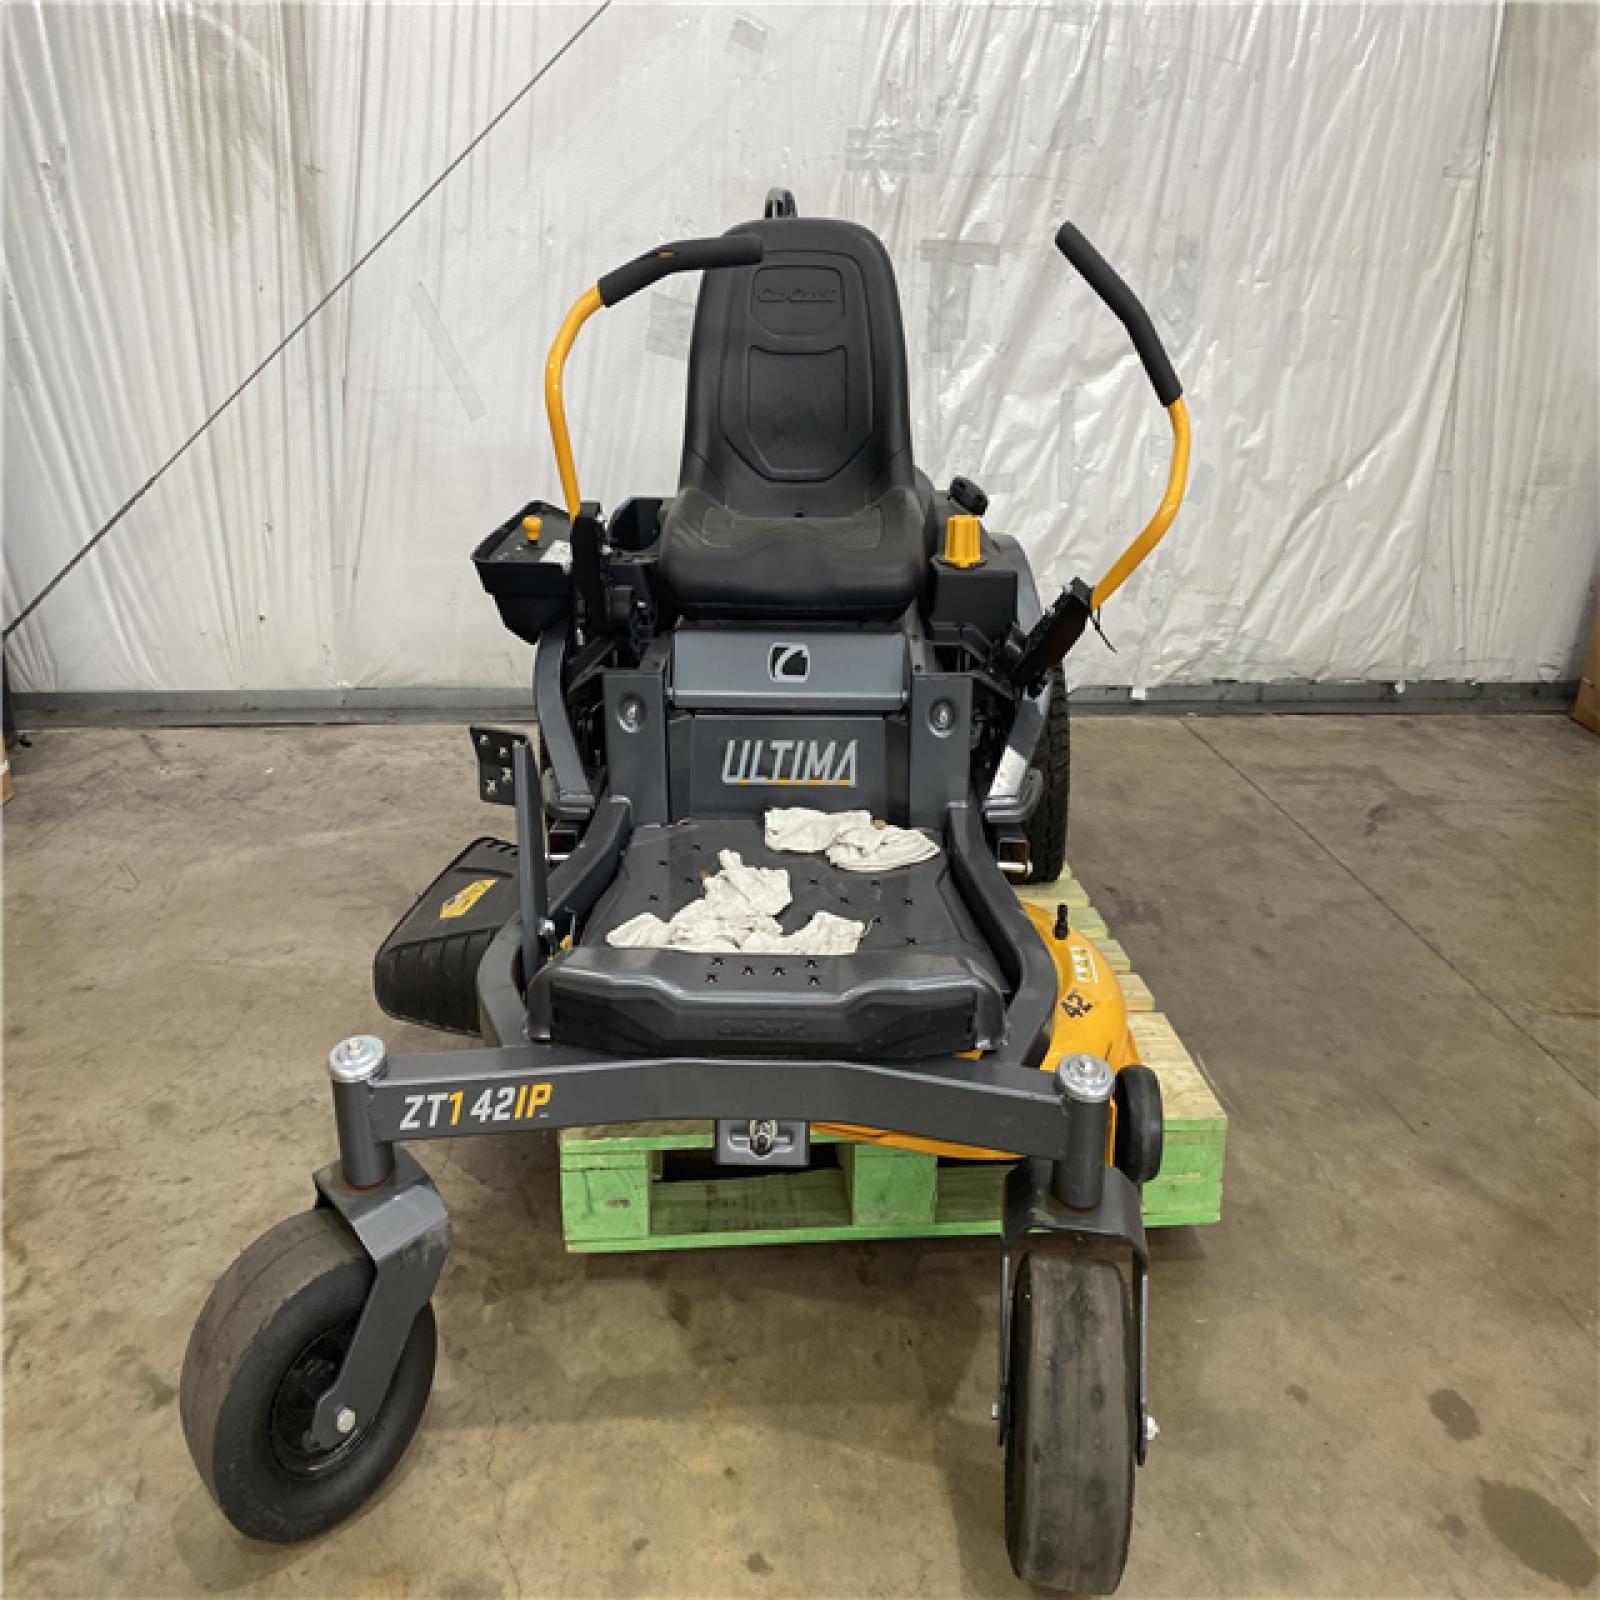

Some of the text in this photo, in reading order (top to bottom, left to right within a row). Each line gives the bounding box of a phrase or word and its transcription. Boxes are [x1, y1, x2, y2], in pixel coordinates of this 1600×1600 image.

[722, 739, 857, 787] ULTIMA
[400, 1083, 553, 1130] ZT1 42IP
